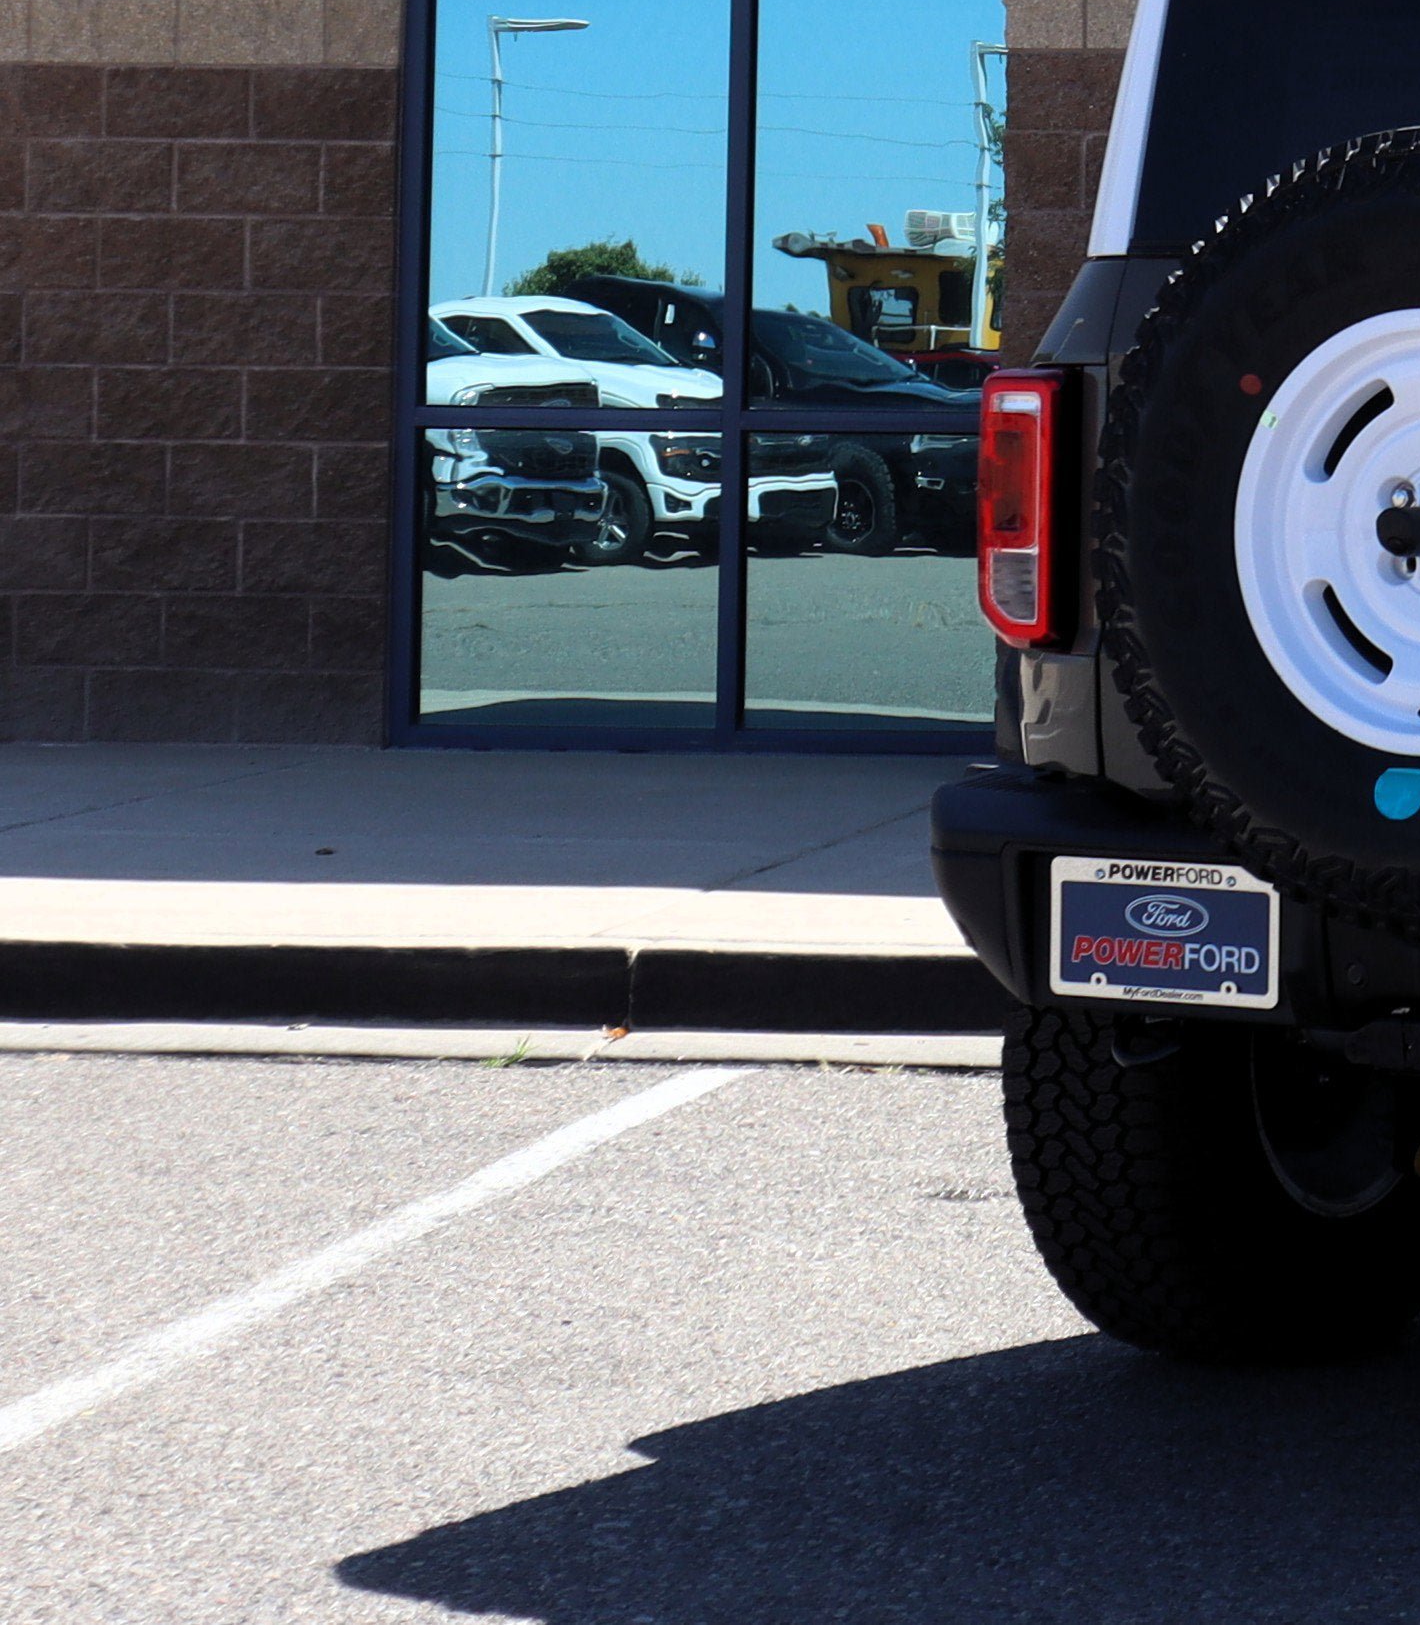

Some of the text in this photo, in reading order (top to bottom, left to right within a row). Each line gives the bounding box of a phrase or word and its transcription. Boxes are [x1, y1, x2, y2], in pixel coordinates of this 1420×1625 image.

[1109, 863, 1223, 886] POWERFORD
[1141, 901, 1192, 929] Ford
[1071, 935, 1260, 975] POWERFORD
